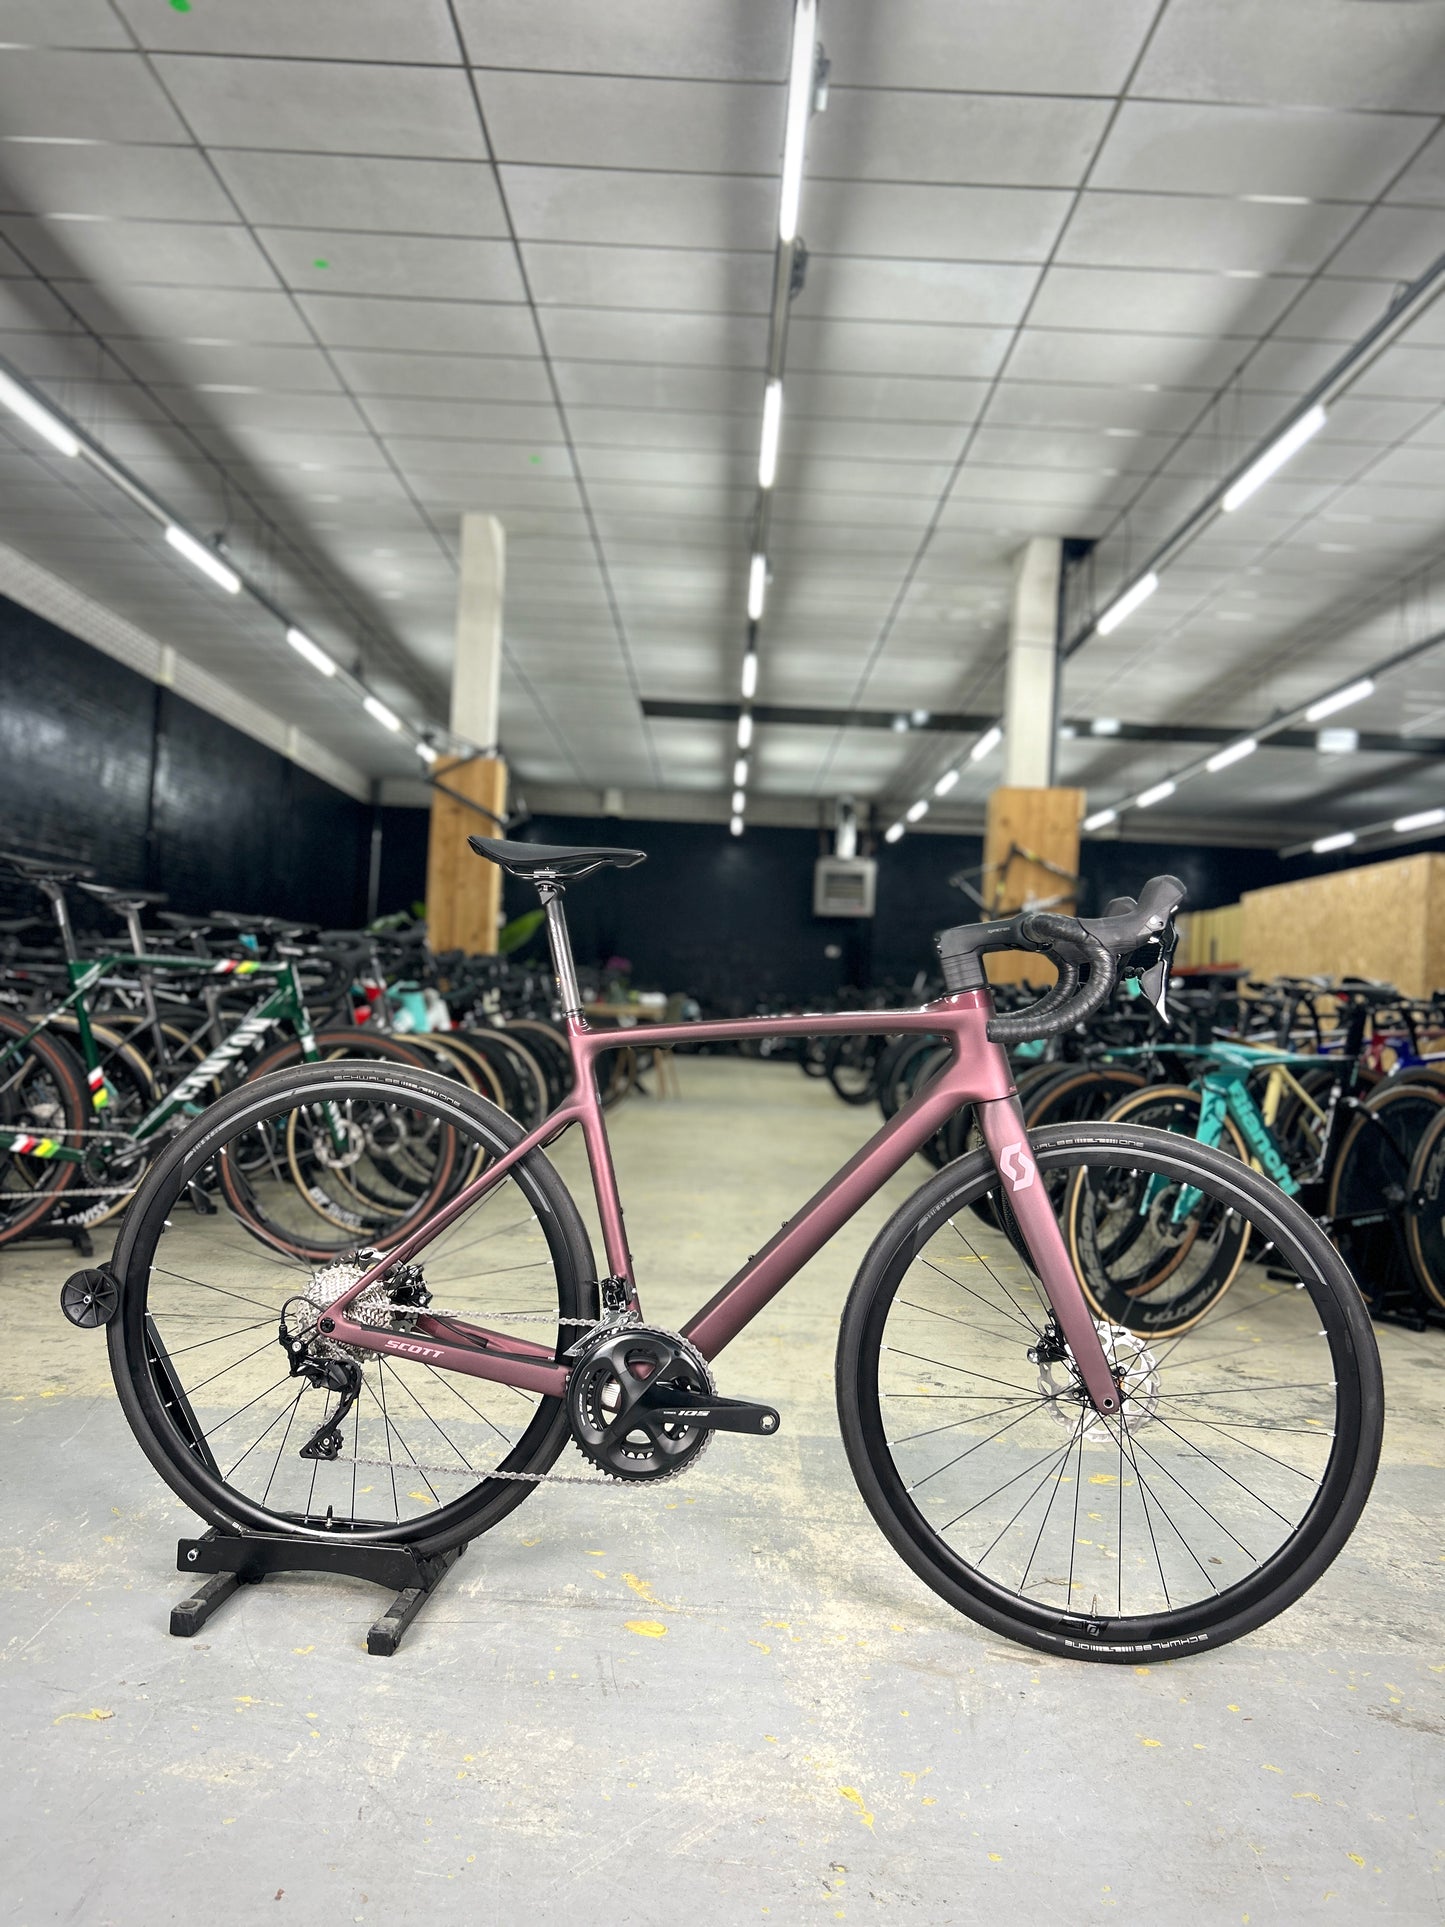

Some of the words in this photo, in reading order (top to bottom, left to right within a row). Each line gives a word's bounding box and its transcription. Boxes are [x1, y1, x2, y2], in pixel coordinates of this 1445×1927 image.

[172, 1018, 273, 1100] CANYON
[333, 1075, 400, 1085] SCHWALBE
[1119, 1140, 1144, 1148] ONE
[1228, 1080, 1301, 1196] Bianchi
[385, 1340, 444, 1358] SCOTT
[1135, 1633, 1209, 1651] SCHWALBE
